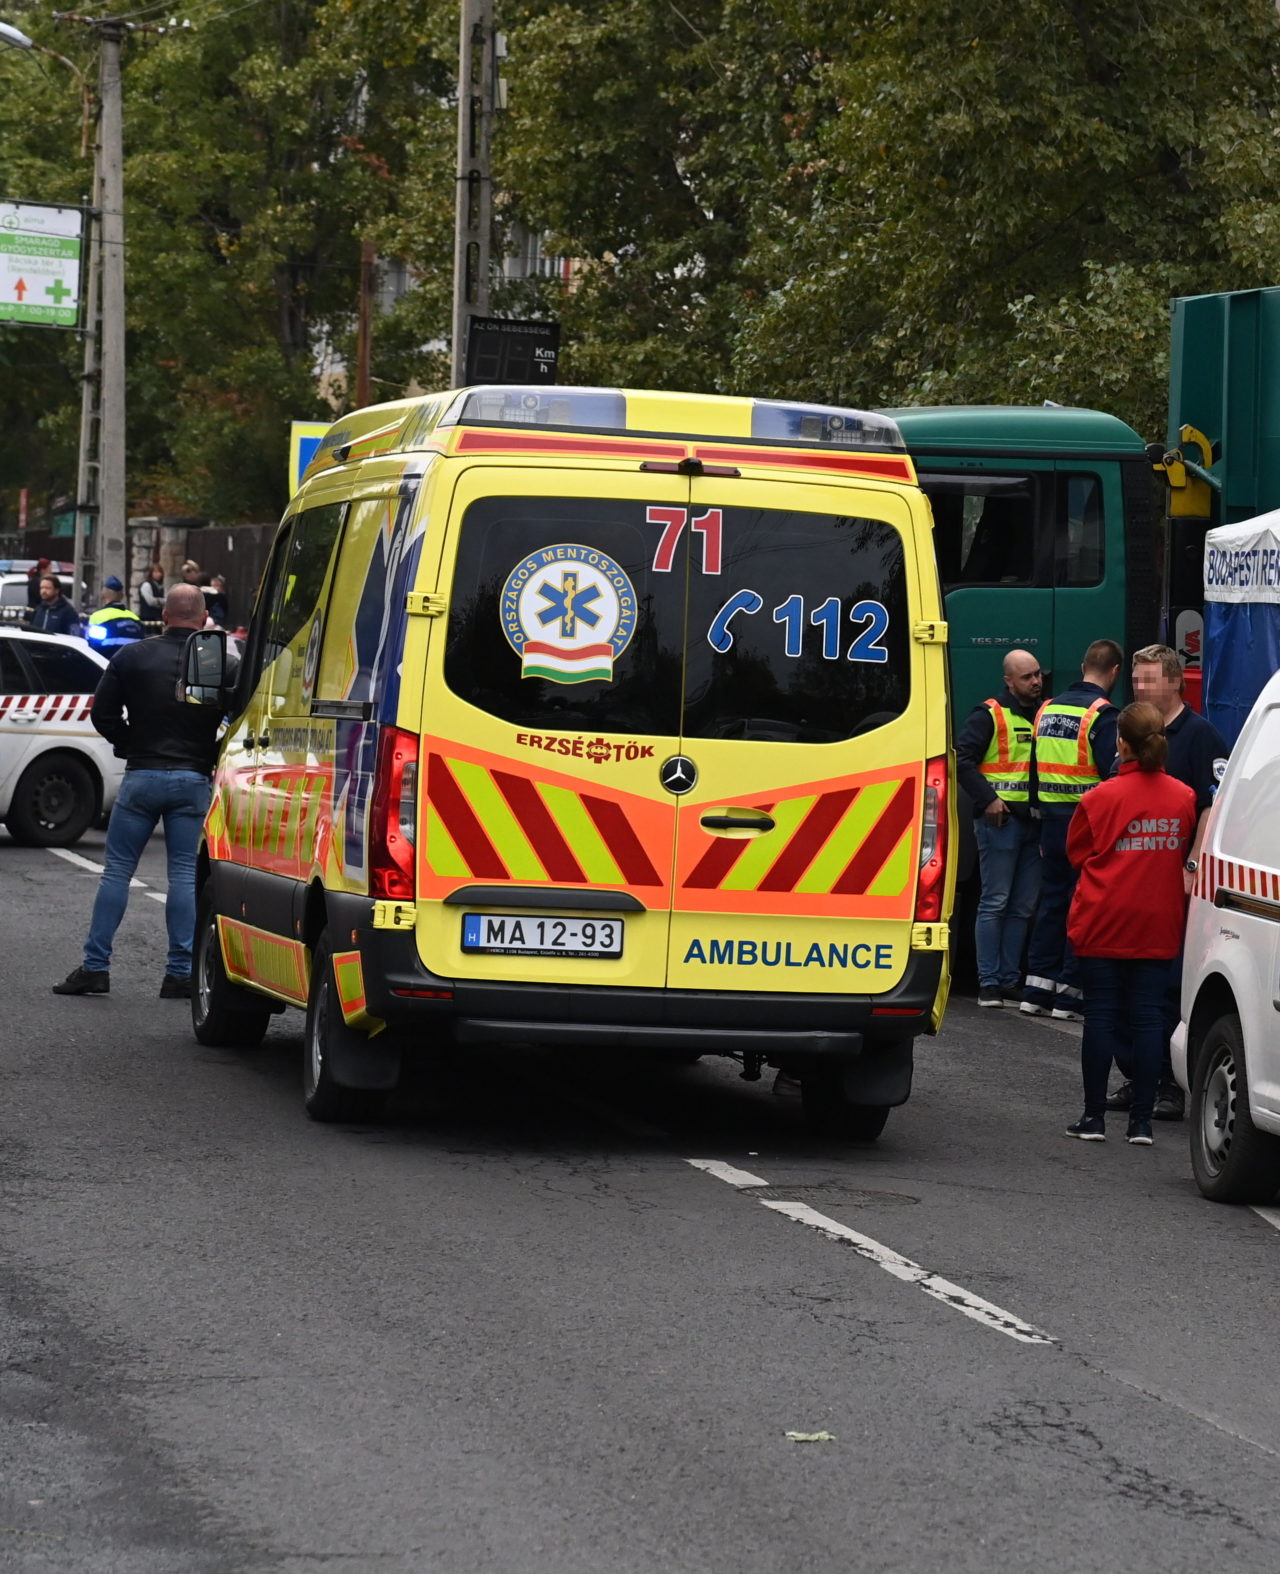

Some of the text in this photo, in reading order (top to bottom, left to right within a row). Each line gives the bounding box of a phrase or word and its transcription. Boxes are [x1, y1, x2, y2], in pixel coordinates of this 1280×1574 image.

[535, 347, 555, 358] Km
[540, 362, 548, 373] h
[646, 505, 722, 575] 71
[1207, 549, 1261, 585] BUDAPESTI
[505, 548, 635, 647] ORSZÁGOS MENTŐSZOLGÁLAT
[773, 594, 889, 663] 112
[1178, 629, 1201, 669] YVA
[516, 733, 584, 758] ERZSÉ
[1127, 818, 1180, 834] OMSZ
[468, 933, 476, 942] H
[486, 919, 615, 948] MA 12-93
[683, 939, 893, 969] AMBULANCE
